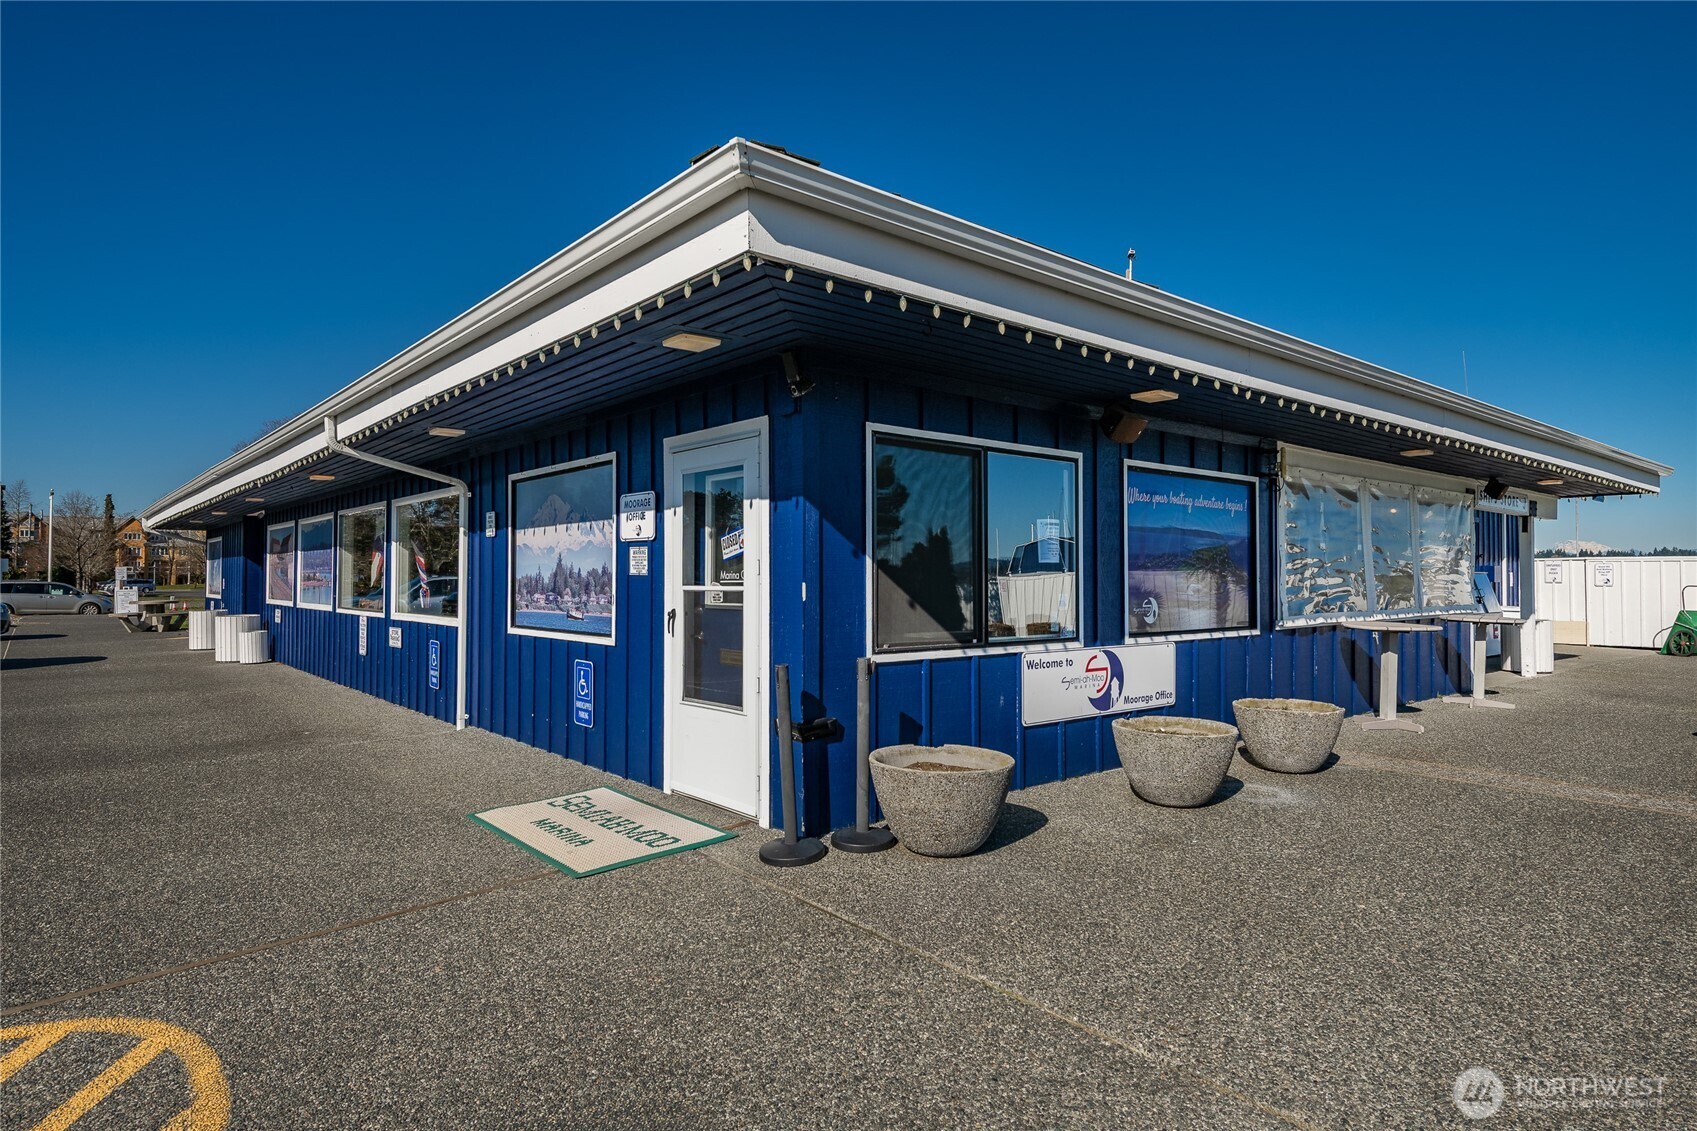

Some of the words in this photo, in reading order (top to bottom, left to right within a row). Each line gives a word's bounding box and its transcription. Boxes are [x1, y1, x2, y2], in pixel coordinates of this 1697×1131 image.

[624, 498, 651, 509] MOORAGE
[1128, 486, 1152, 504] Where
[1152, 494, 1168, 509] your
[1170, 491, 1193, 513] boating
[1194, 495, 1225, 510] adventure
[628, 511, 646, 521] OFFICE
[722, 533, 738, 550] CLOSED
[720, 570, 739, 580] Marina
[1026, 658, 1063, 670] Welcome
[1066, 657, 1074, 667] to
[1061, 674, 1104, 690] Semi-ah-Moo
[1124, 695, 1153, 705] Moorage
[1155, 690, 1173, 701] Office
[530, 818, 595, 847] MARINA
